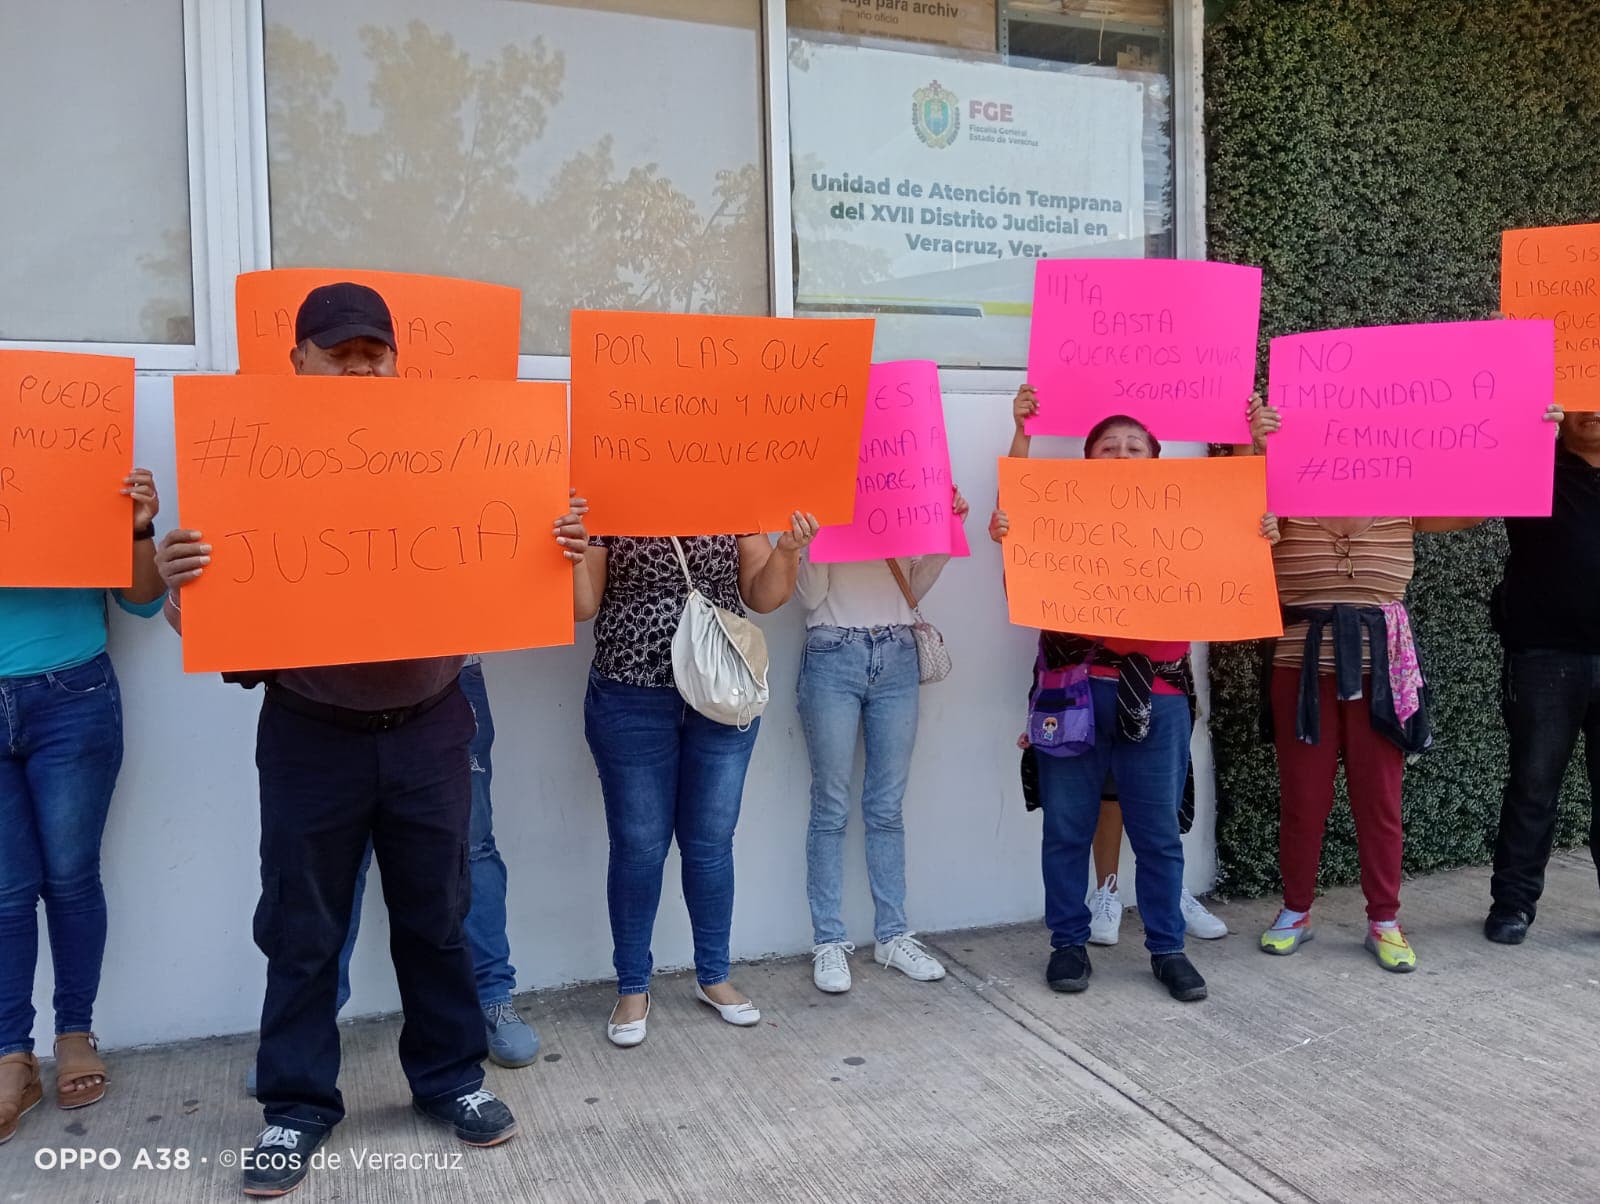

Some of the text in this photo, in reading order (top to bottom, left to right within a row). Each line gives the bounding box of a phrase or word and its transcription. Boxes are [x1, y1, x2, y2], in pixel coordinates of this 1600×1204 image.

[912, 2, 961, 18] archiv
[968, 100, 1014, 123] FGE
[968, 133, 1039, 147] Estado de Veracruz
[811, 172, 1123, 213] Unidad de Atención Temprana
[830, 201, 1108, 237] del XVII Distrito Judicial en
[905, 232, 1049, 259] Veracruz, Ver.
[1092, 308, 1174, 337] BASTA
[595, 332, 830, 373] POR LAS QUE
[1058, 339, 1244, 372] QUEREMOS VIVIR
[1298, 340, 1353, 374] NO
[19, 375, 123, 413] PUEDE
[608, 384, 849, 417] SALIERON Y NUNCA
[1278, 369, 1496, 410] IMPUNIDAD A
[12, 423, 123, 455] MUJER
[593, 434, 820, 466] MAS VOLVIERON
[1324, 417, 1499, 450] FEMINICIDAS
[1296, 455, 1413, 484] #BASTA
[1019, 473, 1183, 511] SER UNA
[867, 502, 944, 535] O HIJA
[224, 500, 520, 584] JUSTICIA
[1152, 525, 1204, 551] NO
[1012, 543, 1180, 580] DEBERIA SER
[1072, 580, 1255, 606] SENTENCIA DE
